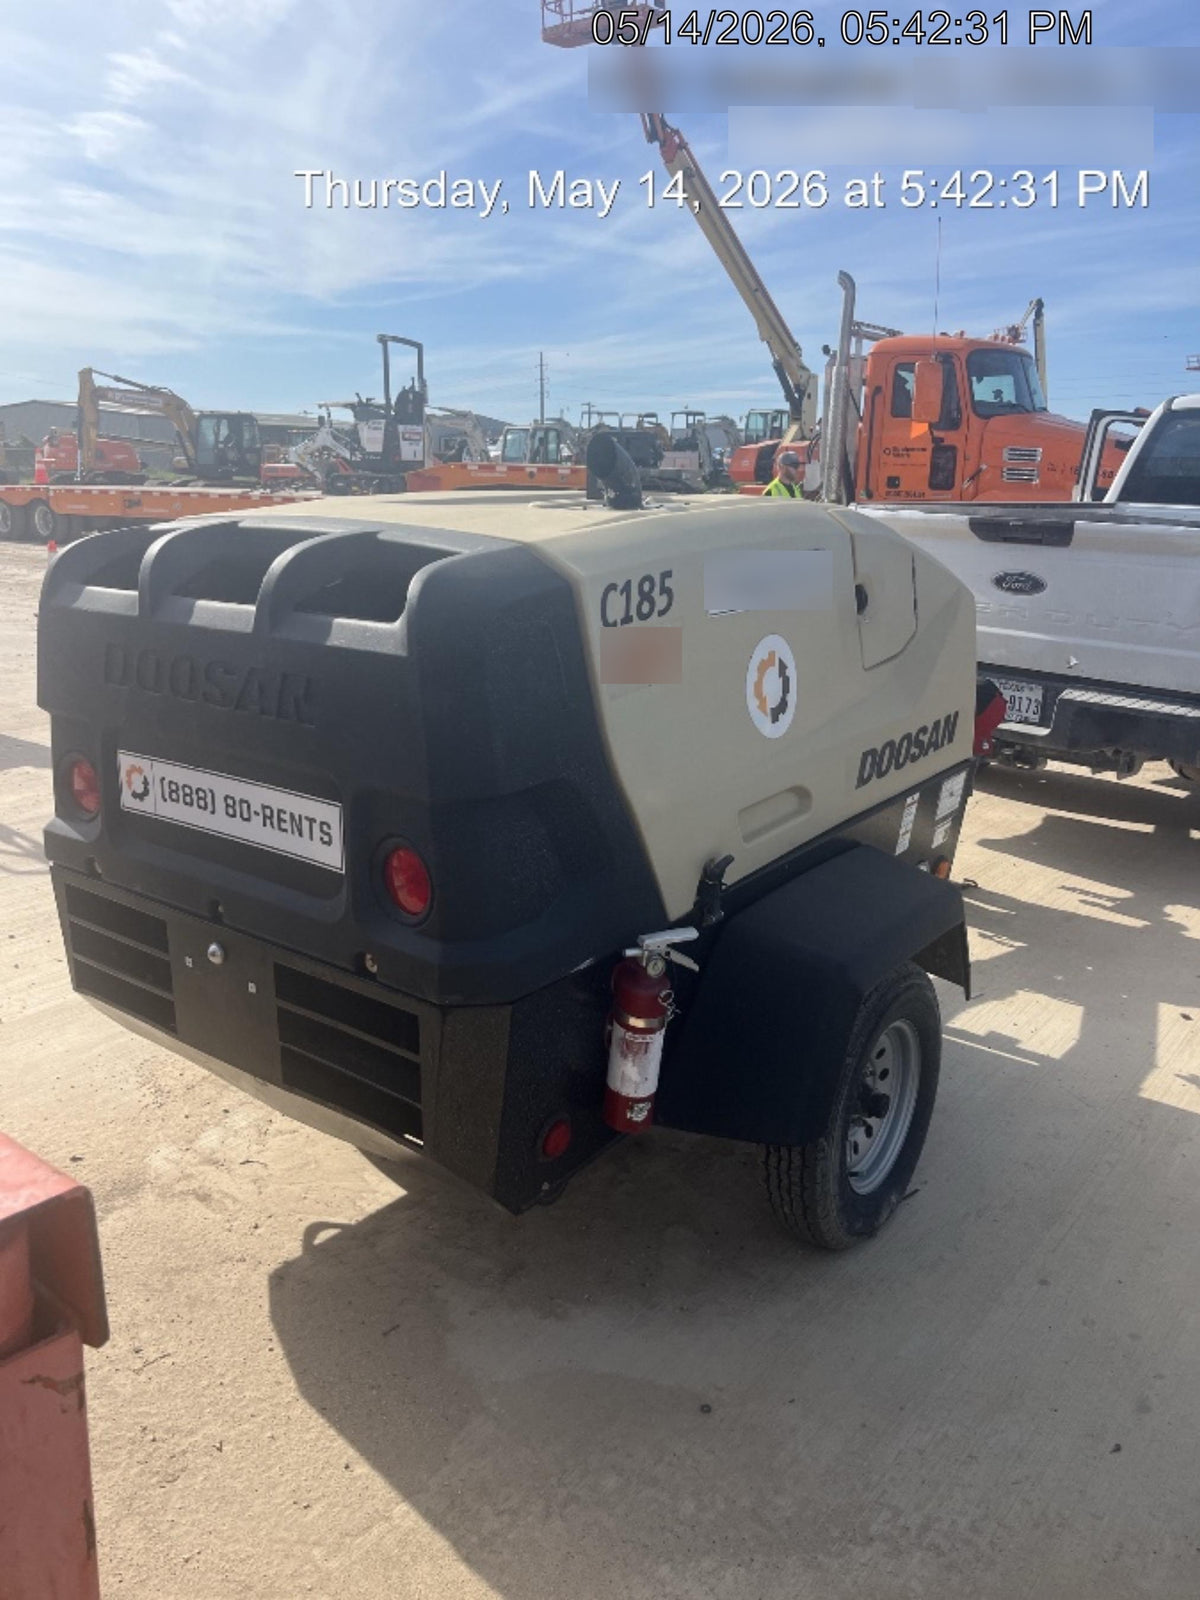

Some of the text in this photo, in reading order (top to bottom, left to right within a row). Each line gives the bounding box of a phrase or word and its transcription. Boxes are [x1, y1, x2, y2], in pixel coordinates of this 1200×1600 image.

[600, 569, 675, 628] C185
[103, 641, 316, 729] DOOSAN
[855, 710, 960, 791] DOOSAN
[159, 776, 334, 848] (888) 80-RENTS
